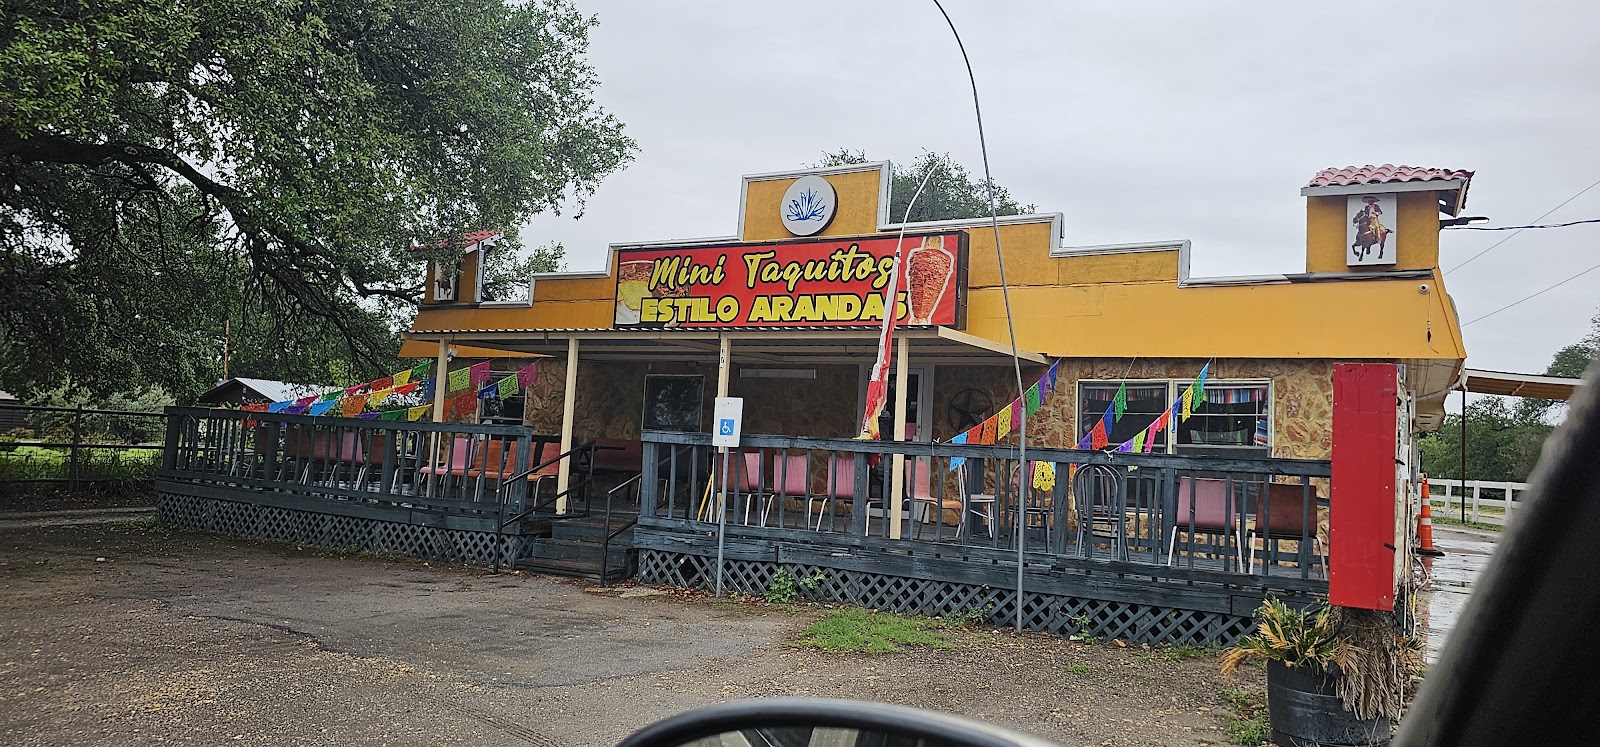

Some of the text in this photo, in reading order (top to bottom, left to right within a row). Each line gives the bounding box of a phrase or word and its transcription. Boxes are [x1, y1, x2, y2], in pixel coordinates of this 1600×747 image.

[649, 245, 894, 291] Mini Taquitos
[641, 297, 739, 323] ESTILO
